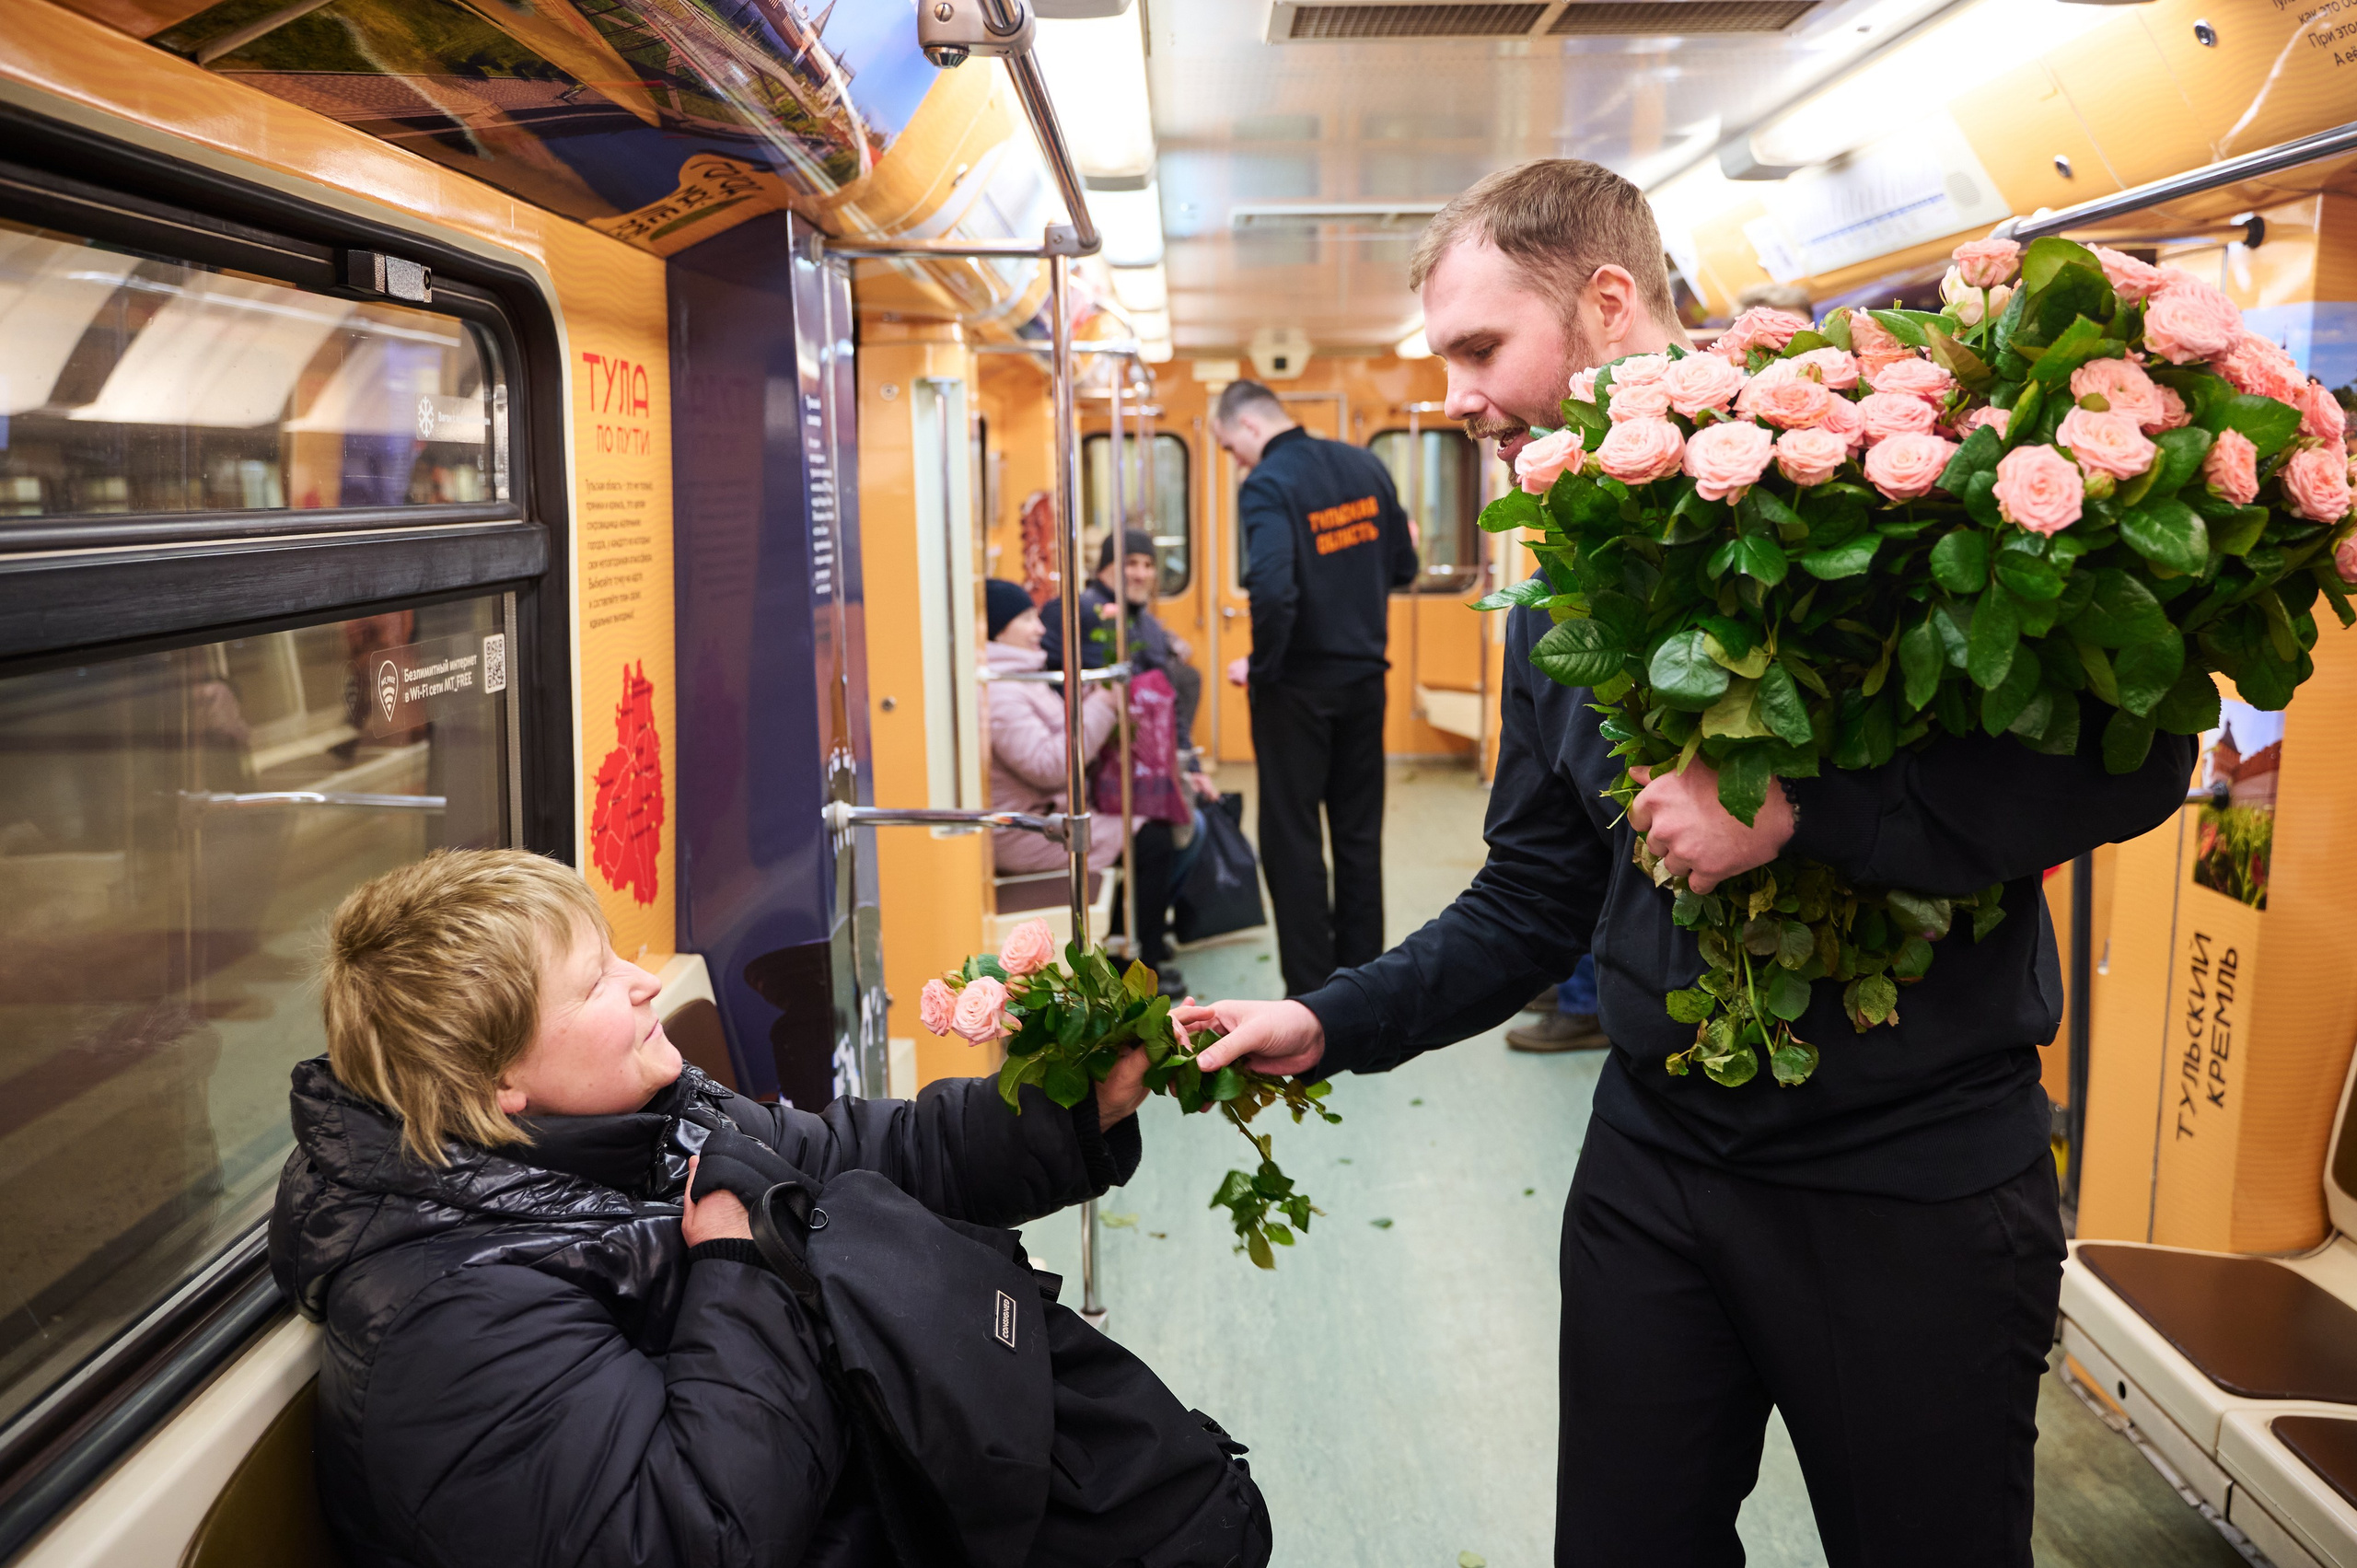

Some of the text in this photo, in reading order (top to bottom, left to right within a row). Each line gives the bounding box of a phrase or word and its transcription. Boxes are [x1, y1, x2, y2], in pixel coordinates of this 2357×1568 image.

[2298, 8, 2317, 25] как
[2319, 1, 2340, 17] это
[2307, 21, 2357, 49] При это
[2334, 52, 2346, 67] А
[582, 352, 649, 418] ТУЛА
[597, 424, 650, 455] ПО ПУТИ
[403, 655, 477, 683] Безлимитный интернет
[404, 672, 473, 703] в Wi-Fi сети MT_FREE
[2176, 930, 2212, 1142] ТУЛЬСКИЙ
[2206, 947, 2237, 1109] КРЕМЛЬ
[1002, 1298, 1010, 1339] CONSIGNED
